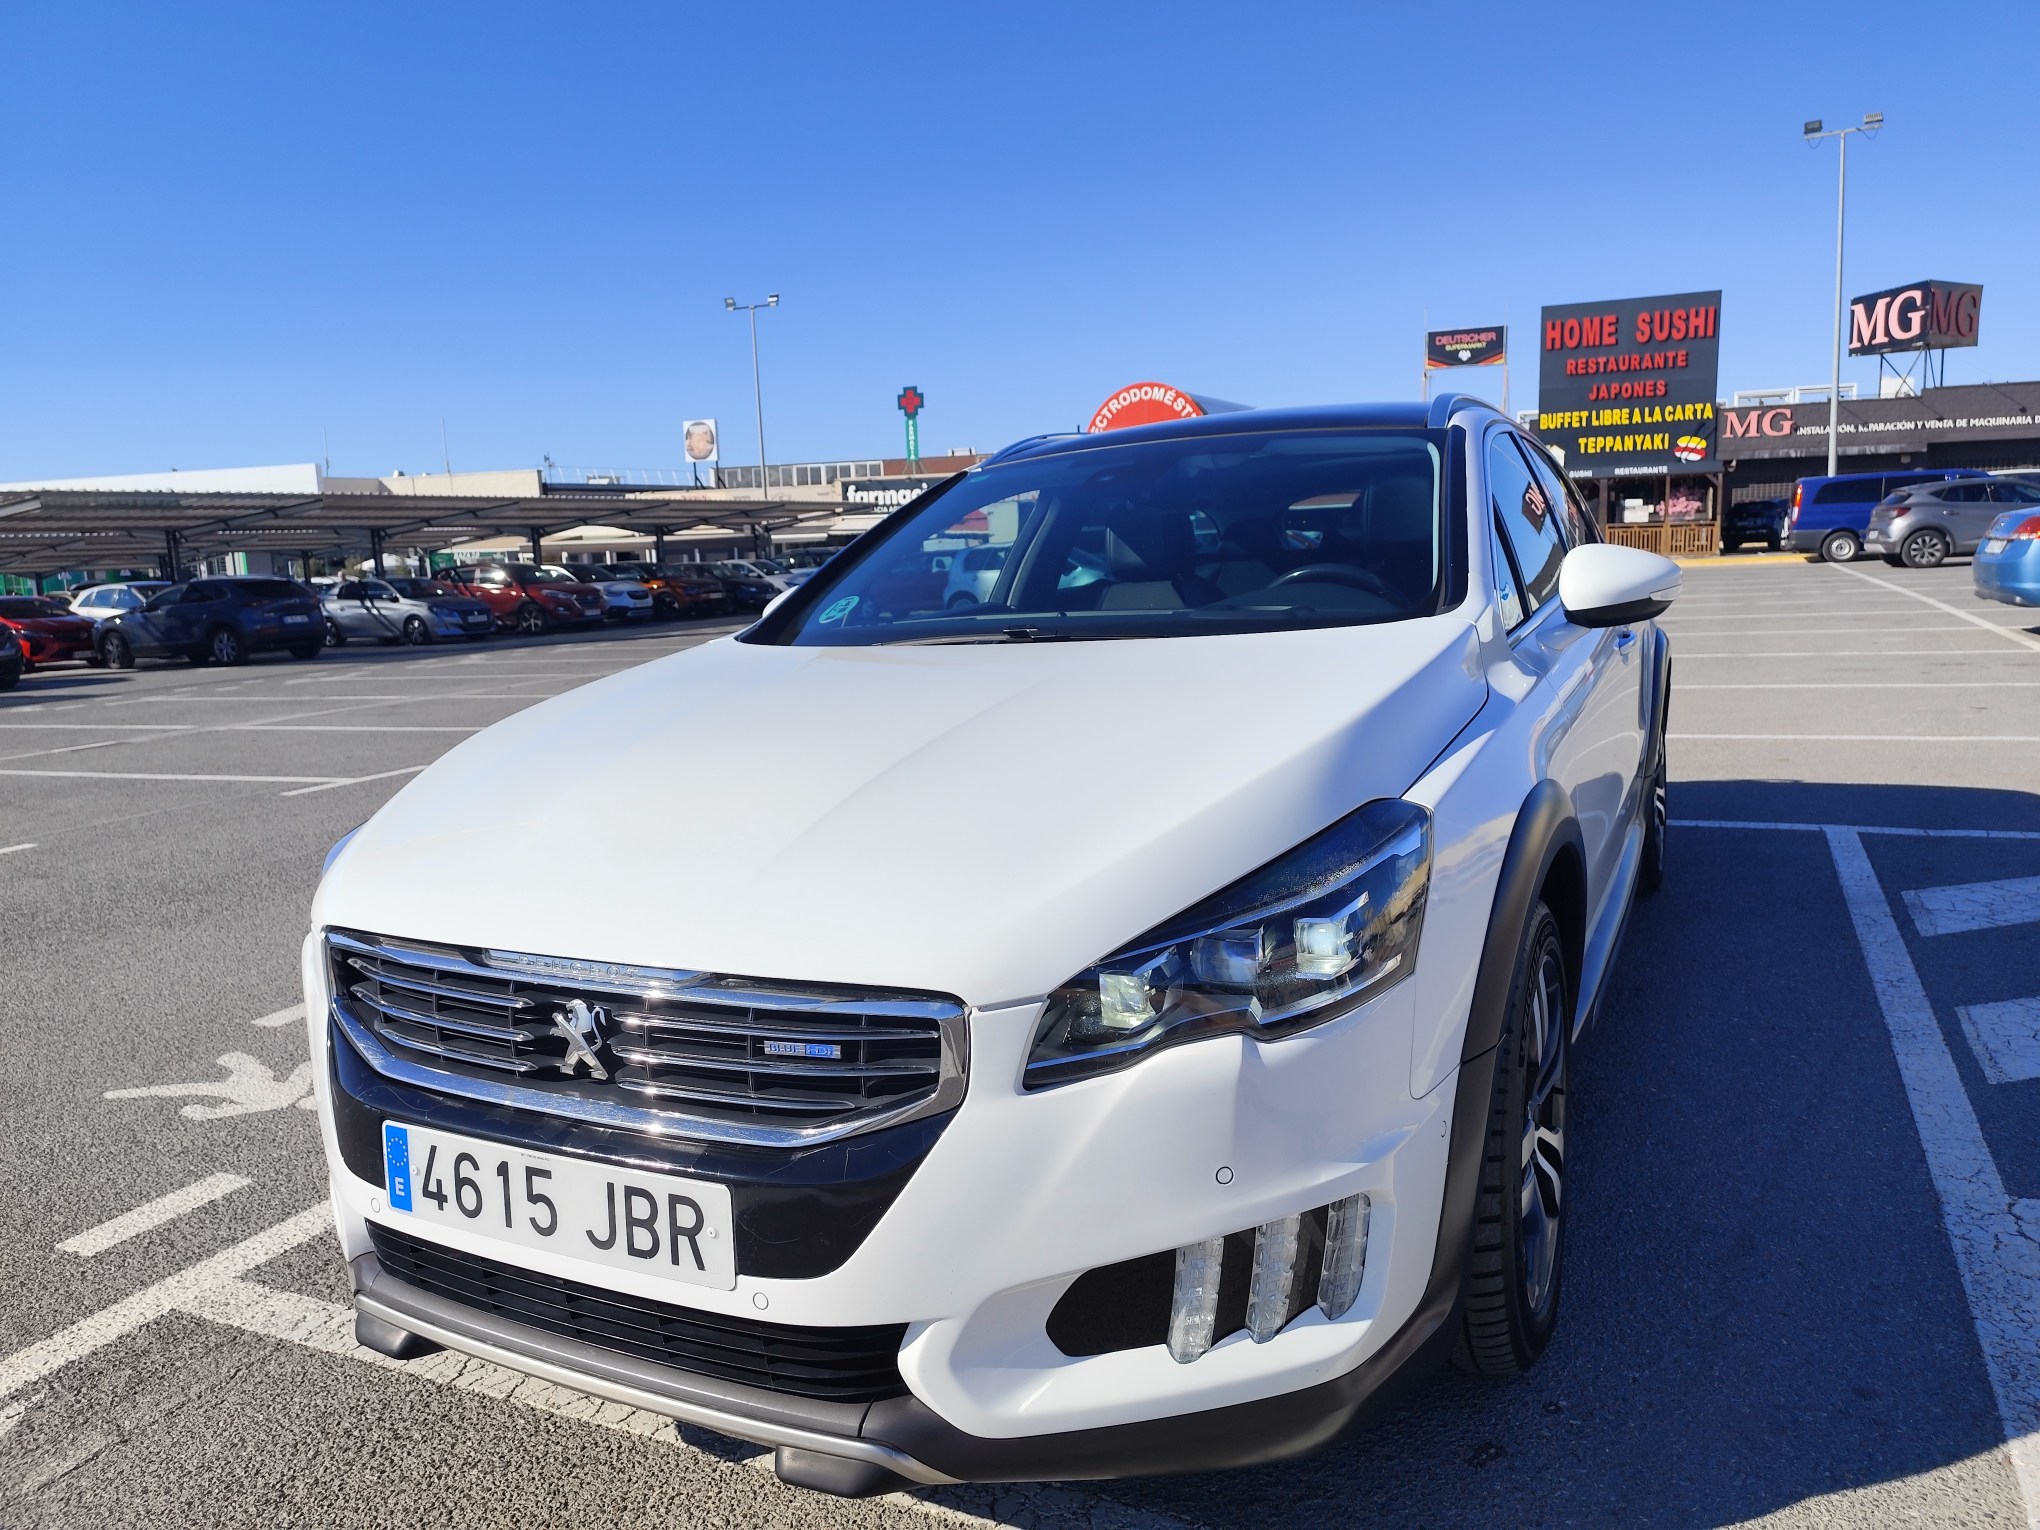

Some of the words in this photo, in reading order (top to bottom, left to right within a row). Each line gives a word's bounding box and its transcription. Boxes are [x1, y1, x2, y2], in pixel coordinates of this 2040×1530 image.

[1850, 290, 1926, 349] MG
[1930, 288, 1980, 337] MG
[1435, 331, 1496, 346] DEUTSCHER
[1546, 315, 1618, 350] HOME
[1635, 306, 1716, 343] SUSHI
[1566, 350, 1688, 375] RESTAURANTE
[1588, 379, 1667, 401] JAPONES
[1539, 410, 1589, 430] BUFFET
[1591, 407, 1630, 427] LIBRE
[1632, 408, 1642, 424] A
[1644, 406, 1663, 423] LA
[1664, 402, 1714, 422] CARTA
[1722, 408, 1795, 439] MG
[1917, 420, 1924, 430] Y
[1925, 418, 1954, 429] VENTA
[1956, 418, 1967, 428] DE
[1970, 415, 2032, 427] MAQUINARIA
[1578, 433, 1670, 454] TEPPANYAKI
[1614, 466, 1668, 475] RESTAURANTE
[394, 1177, 406, 1197] E
[421, 1144, 558, 1237] 4615
[585, 1181, 707, 1271] JBR
